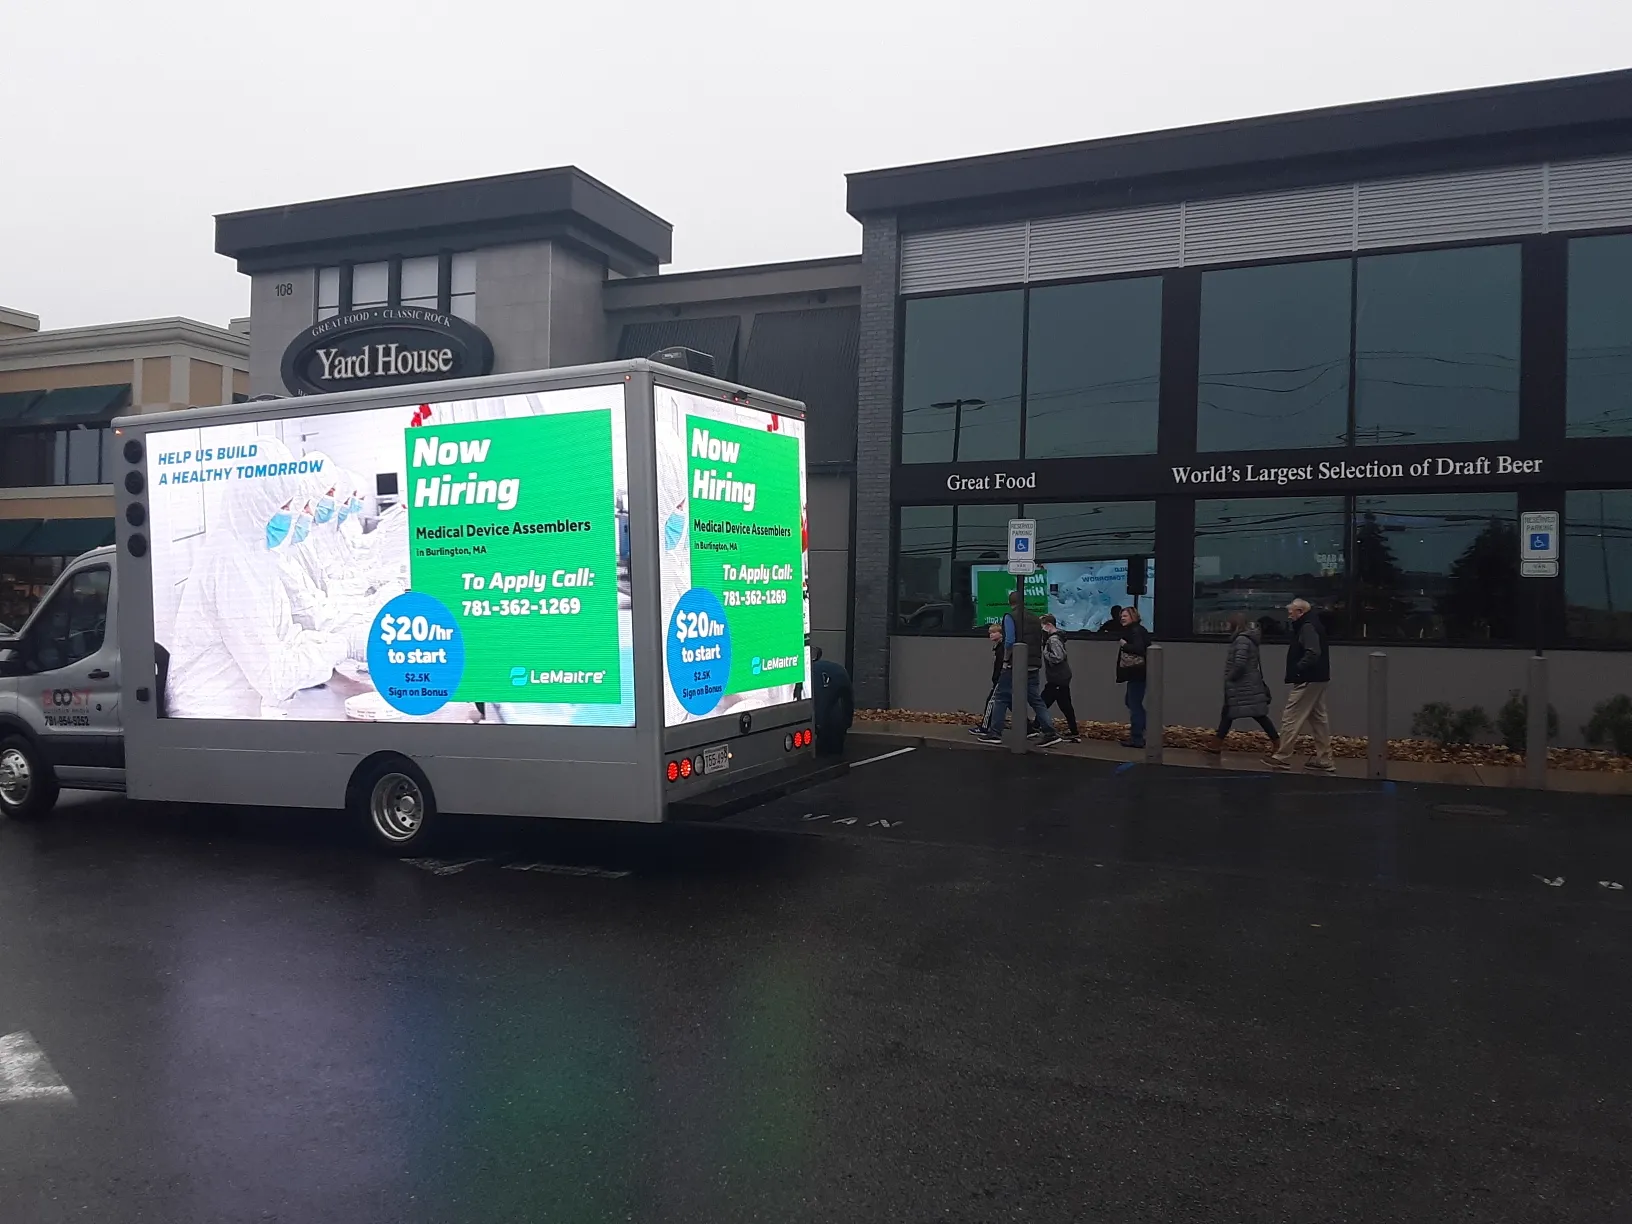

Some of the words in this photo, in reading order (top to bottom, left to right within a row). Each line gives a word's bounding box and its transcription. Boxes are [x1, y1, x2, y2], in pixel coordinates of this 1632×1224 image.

[275, 283, 293, 297] 108
[312, 317, 343, 337] GREAT
[343, 311, 370, 325] FOOD
[383, 309, 423, 321] CLASSIC
[424, 311, 453, 327] ROCK
[316, 345, 370, 380] Yard
[375, 342, 453, 375] House
[158, 450, 191, 465] HELP
[195, 448, 213, 462] US
[217, 444, 258, 460] BUILD
[412, 436, 492, 468] Now
[691, 428, 740, 464] Now
[158, 473, 168, 485] A
[172, 467, 233, 484] HEALTHY
[236, 460, 324, 479] TOMORROW
[1171, 465, 1241, 485] World's
[1245, 462, 1313, 485] Largest
[1318, 460, 1403, 481] Selection
[1409, 458, 1432, 477] of
[1435, 457, 1491, 476] Draft
[1497, 455, 1543, 474] Beer
[414, 472, 520, 511] Hiring
[692, 468, 756, 512] Hiring
[946, 474, 990, 491] Great
[995, 472, 1037, 489] Food
[416, 524, 464, 540] Medical
[466, 522, 510, 538] Device
[512, 518, 591, 535] Assemblers
[693, 518, 725, 534] Medical
[726, 521, 751, 536] Device
[751, 523, 791, 537] Assemblers
[1525, 516, 1556, 524] RESERVED
[416, 548, 424, 557] in
[426, 546, 471, 558] Burlington,
[472, 545, 487, 555] MA
[700, 541, 728, 552] Burlington,
[729, 542, 738, 551] MA
[461, 573, 485, 591] To
[488, 570, 547, 593] Apply
[551, 567, 595, 588] Call:
[722, 564, 737, 581] To
[738, 564, 770, 585] Apply
[772, 563, 793, 581] Call:
[461, 597, 581, 617] 781-362-1269
[722, 589, 787, 607] 781-362-1269
[380, 613, 454, 645] $20/hr
[676, 609, 725, 643] $20/hr
[387, 649, 406, 664] to
[407, 648, 447, 664] start
[681, 646, 694, 663] to
[695, 643, 721, 662] start
[404, 672, 431, 683] $2.5K
[693, 669, 711, 682] $2.5K
[388, 687, 408, 699] Sign
[409, 689, 420, 697] on
[421, 687, 448, 697] Bonus
[682, 687, 697, 699] Sign
[697, 687, 705, 697] on
[704, 684, 723, 696] Bonus
